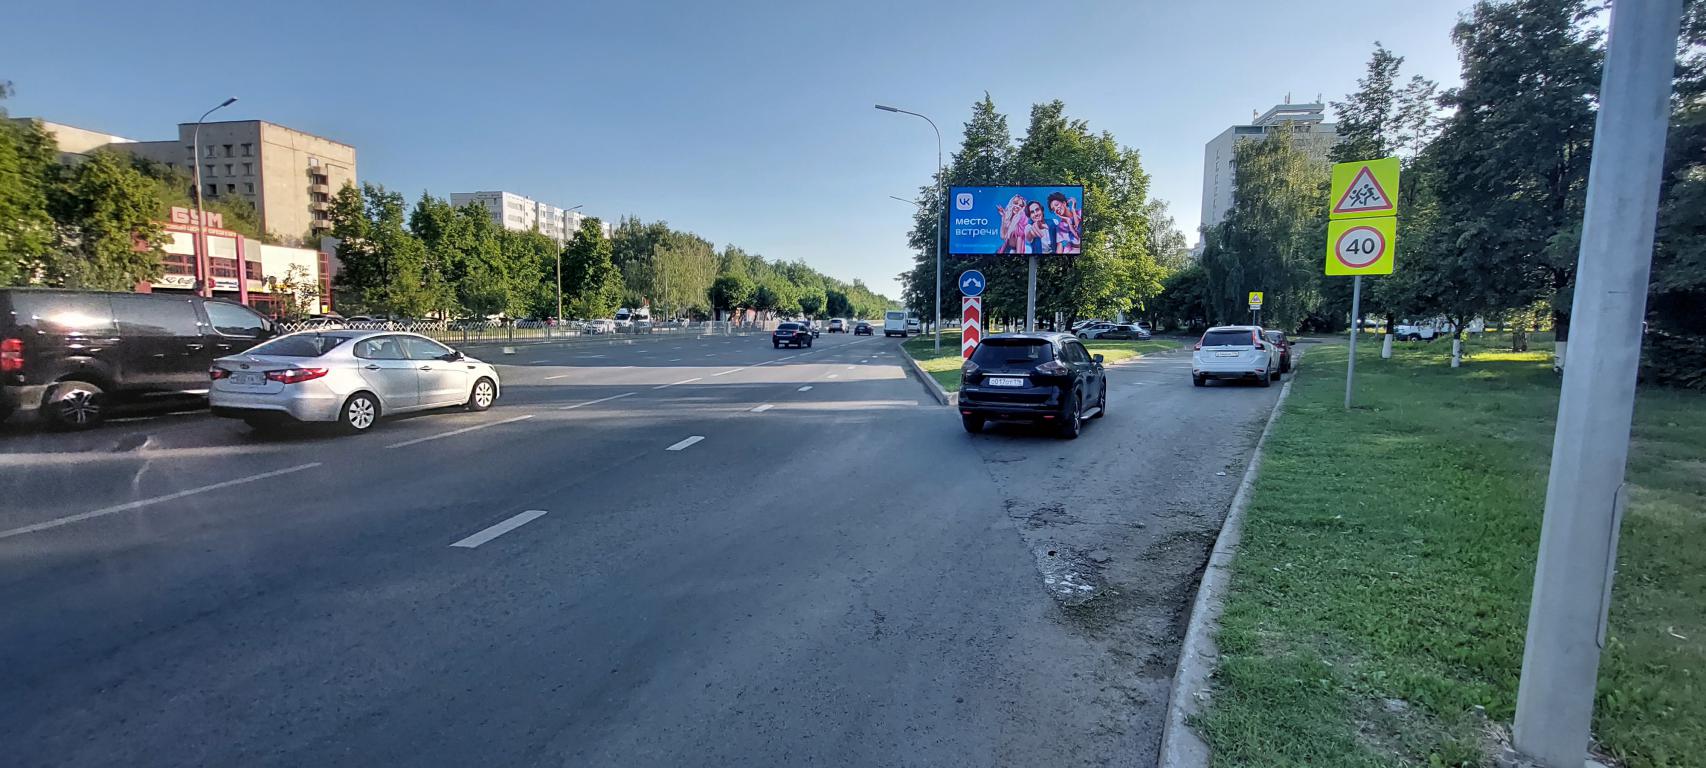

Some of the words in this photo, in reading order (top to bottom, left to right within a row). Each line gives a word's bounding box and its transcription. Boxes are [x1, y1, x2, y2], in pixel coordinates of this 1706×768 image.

[170, 206, 223, 229] БУМ
[955, 218, 988, 226] место
[955, 228, 999, 238] встречи
[1346, 238, 1375, 255] 40
